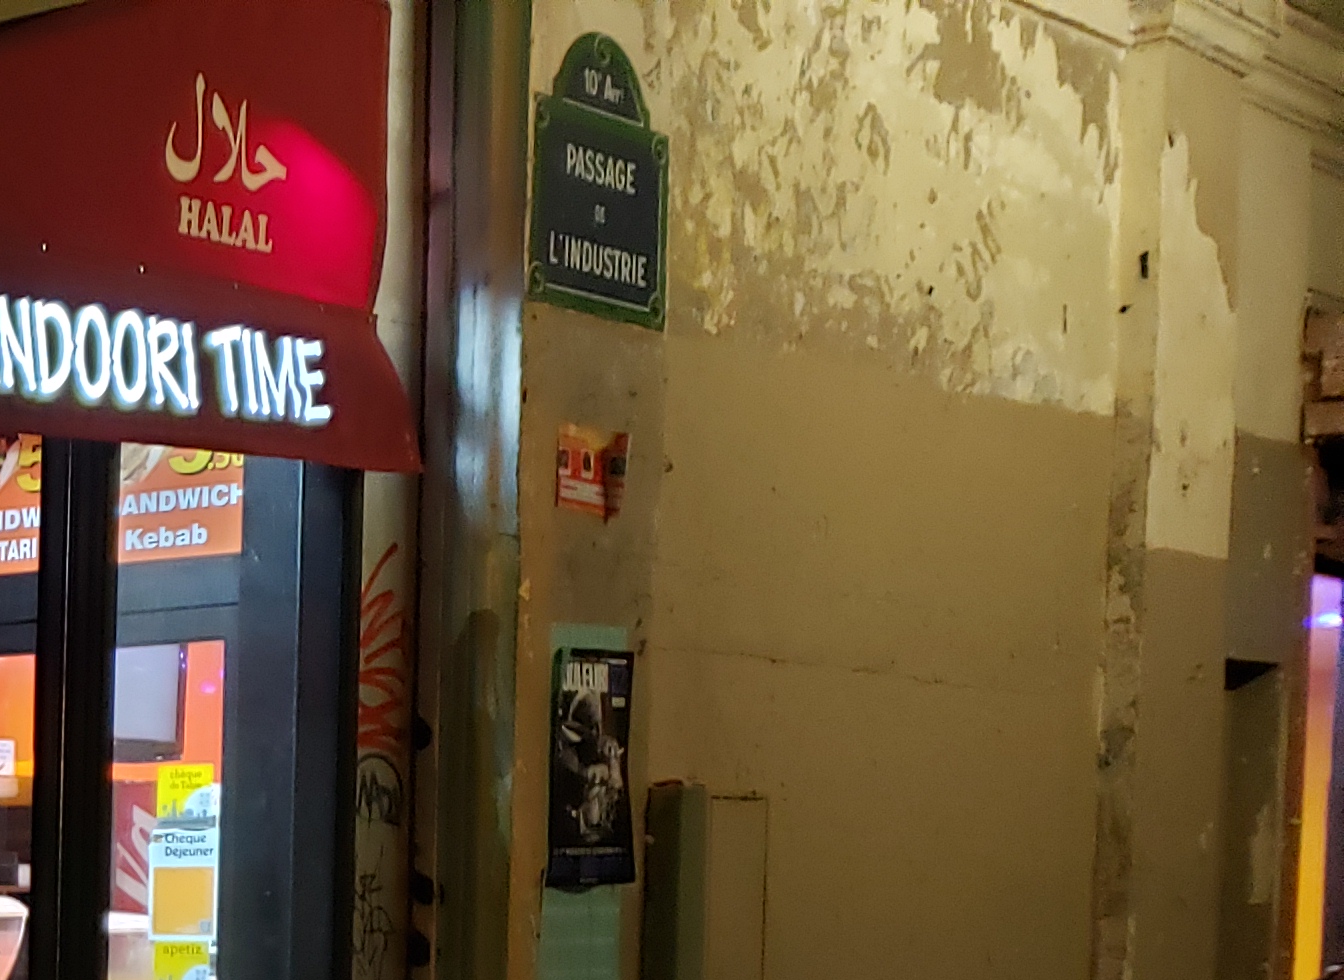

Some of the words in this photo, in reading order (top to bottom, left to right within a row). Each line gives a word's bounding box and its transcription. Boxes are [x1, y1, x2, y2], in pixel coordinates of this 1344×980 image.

[165, 71, 287, 191] حلال
[566, 142, 637, 195] PASSAGE
[178, 196, 272, 253] HALAL
[549, 230, 647, 288] L'INDUSTRIE
[206, 324, 332, 423] TIME
[125, 522, 208, 551] Kebab
